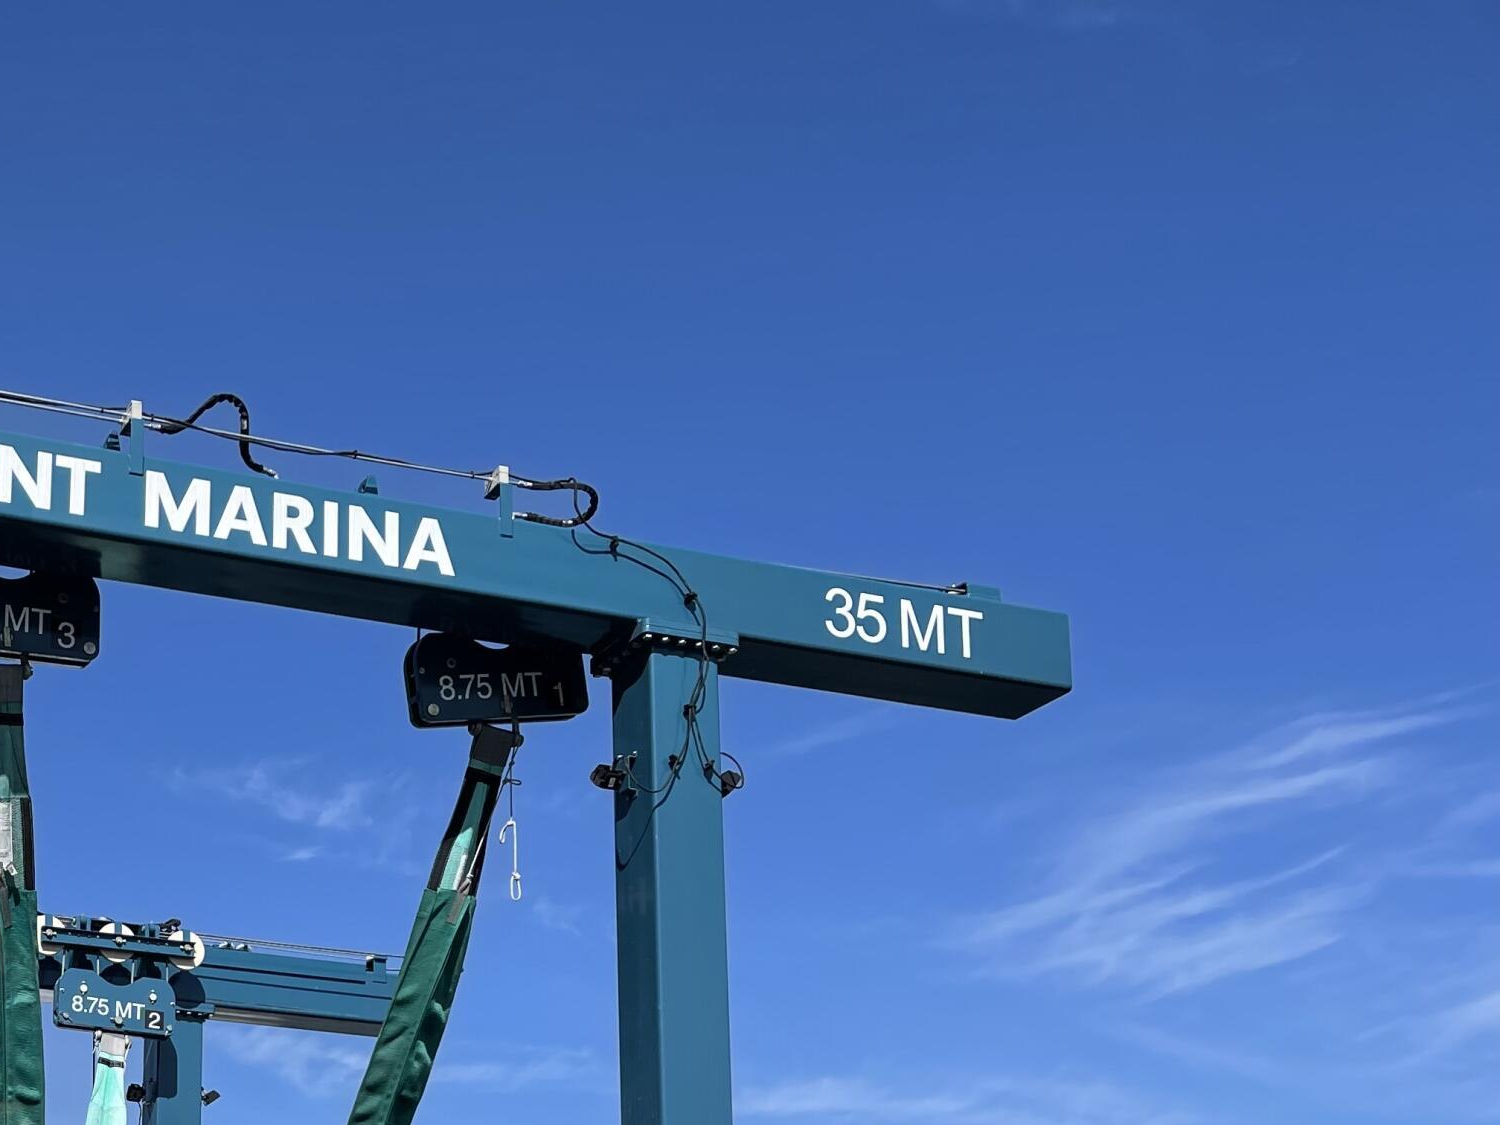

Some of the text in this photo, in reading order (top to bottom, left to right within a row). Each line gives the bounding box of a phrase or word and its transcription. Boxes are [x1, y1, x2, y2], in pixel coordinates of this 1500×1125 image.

[142, 468, 456, 577] MARINA
[4, 604, 52, 635] MT
[824, 587, 984, 659] 35 MT
[57, 622, 76, 649] 3
[438, 672, 543, 701] 8.75 MT
[552, 681, 565, 707] 1
[71, 994, 146, 1020] 8.75 MT
[148, 1012, 161, 1029] 2
